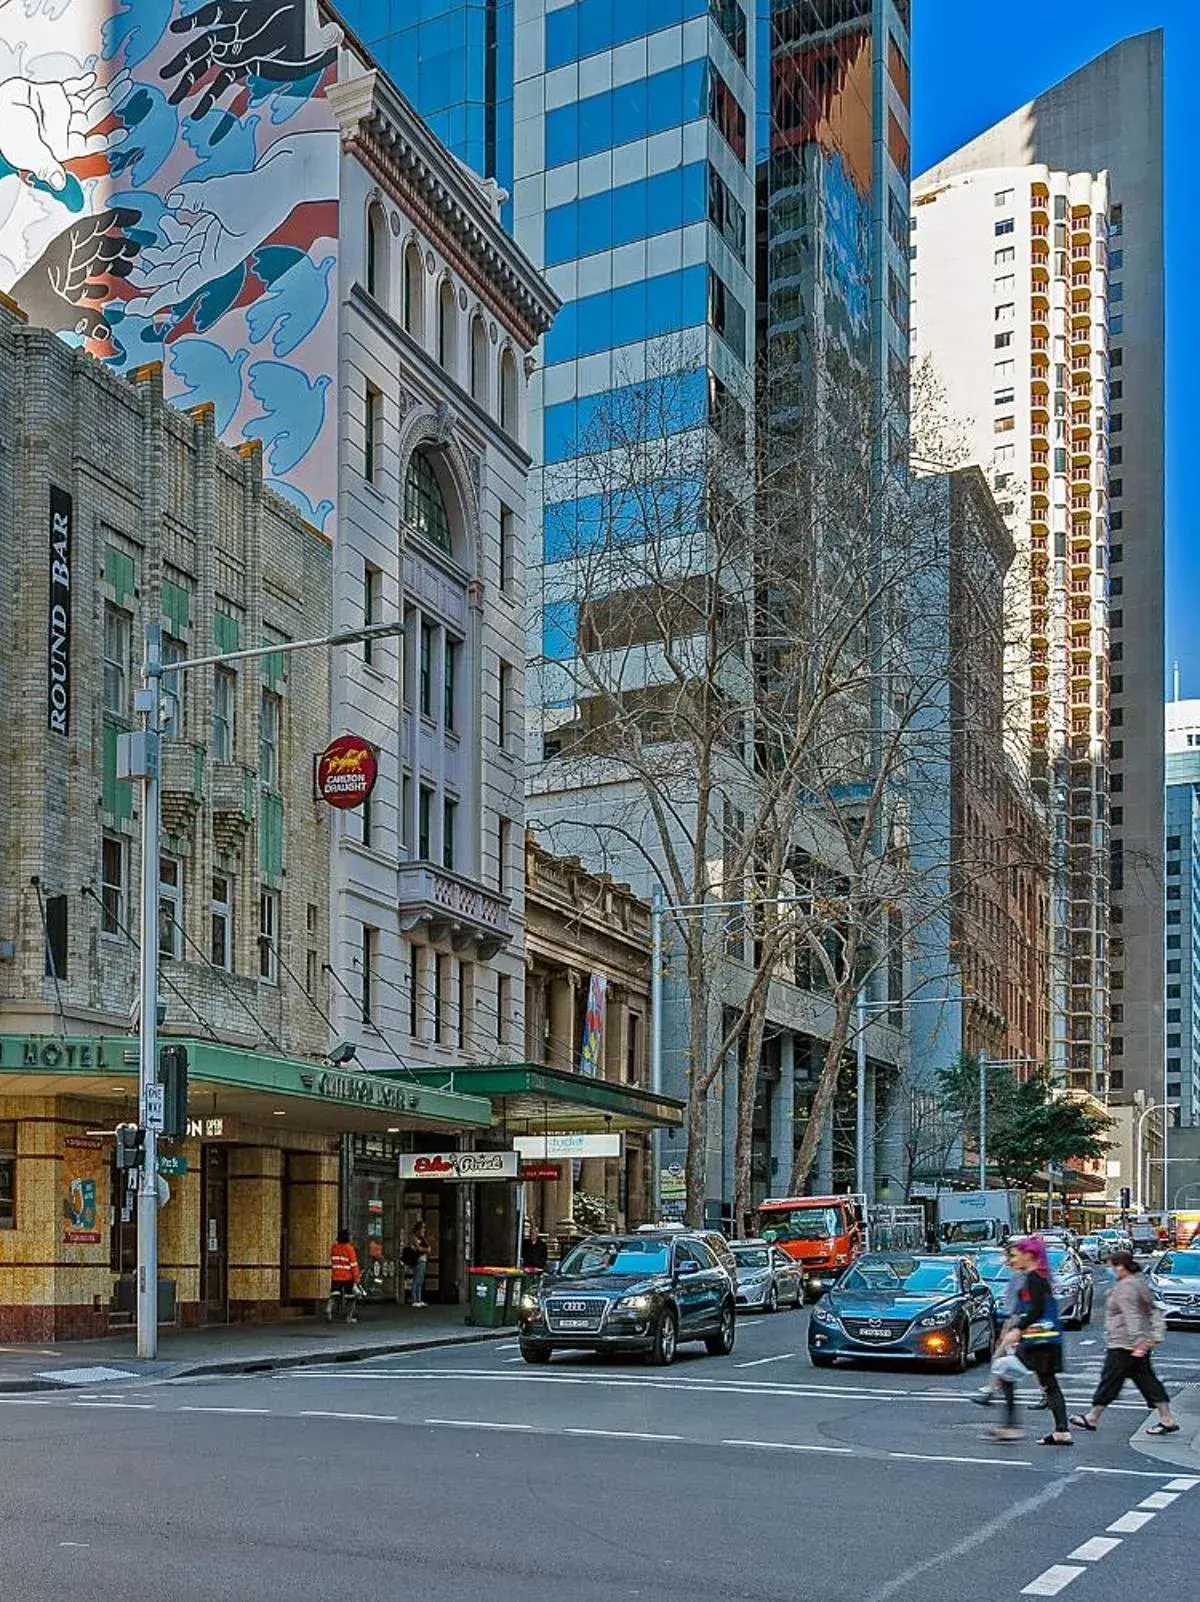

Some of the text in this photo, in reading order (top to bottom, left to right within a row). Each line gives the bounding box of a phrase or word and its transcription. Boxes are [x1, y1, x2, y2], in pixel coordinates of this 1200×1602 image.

[50, 512, 69, 736] ROUND BAR
[324, 782, 368, 793] DRAUGHT
[326, 773, 366, 784] CARLTON
[22, 1041, 108, 1069] HOTEL
